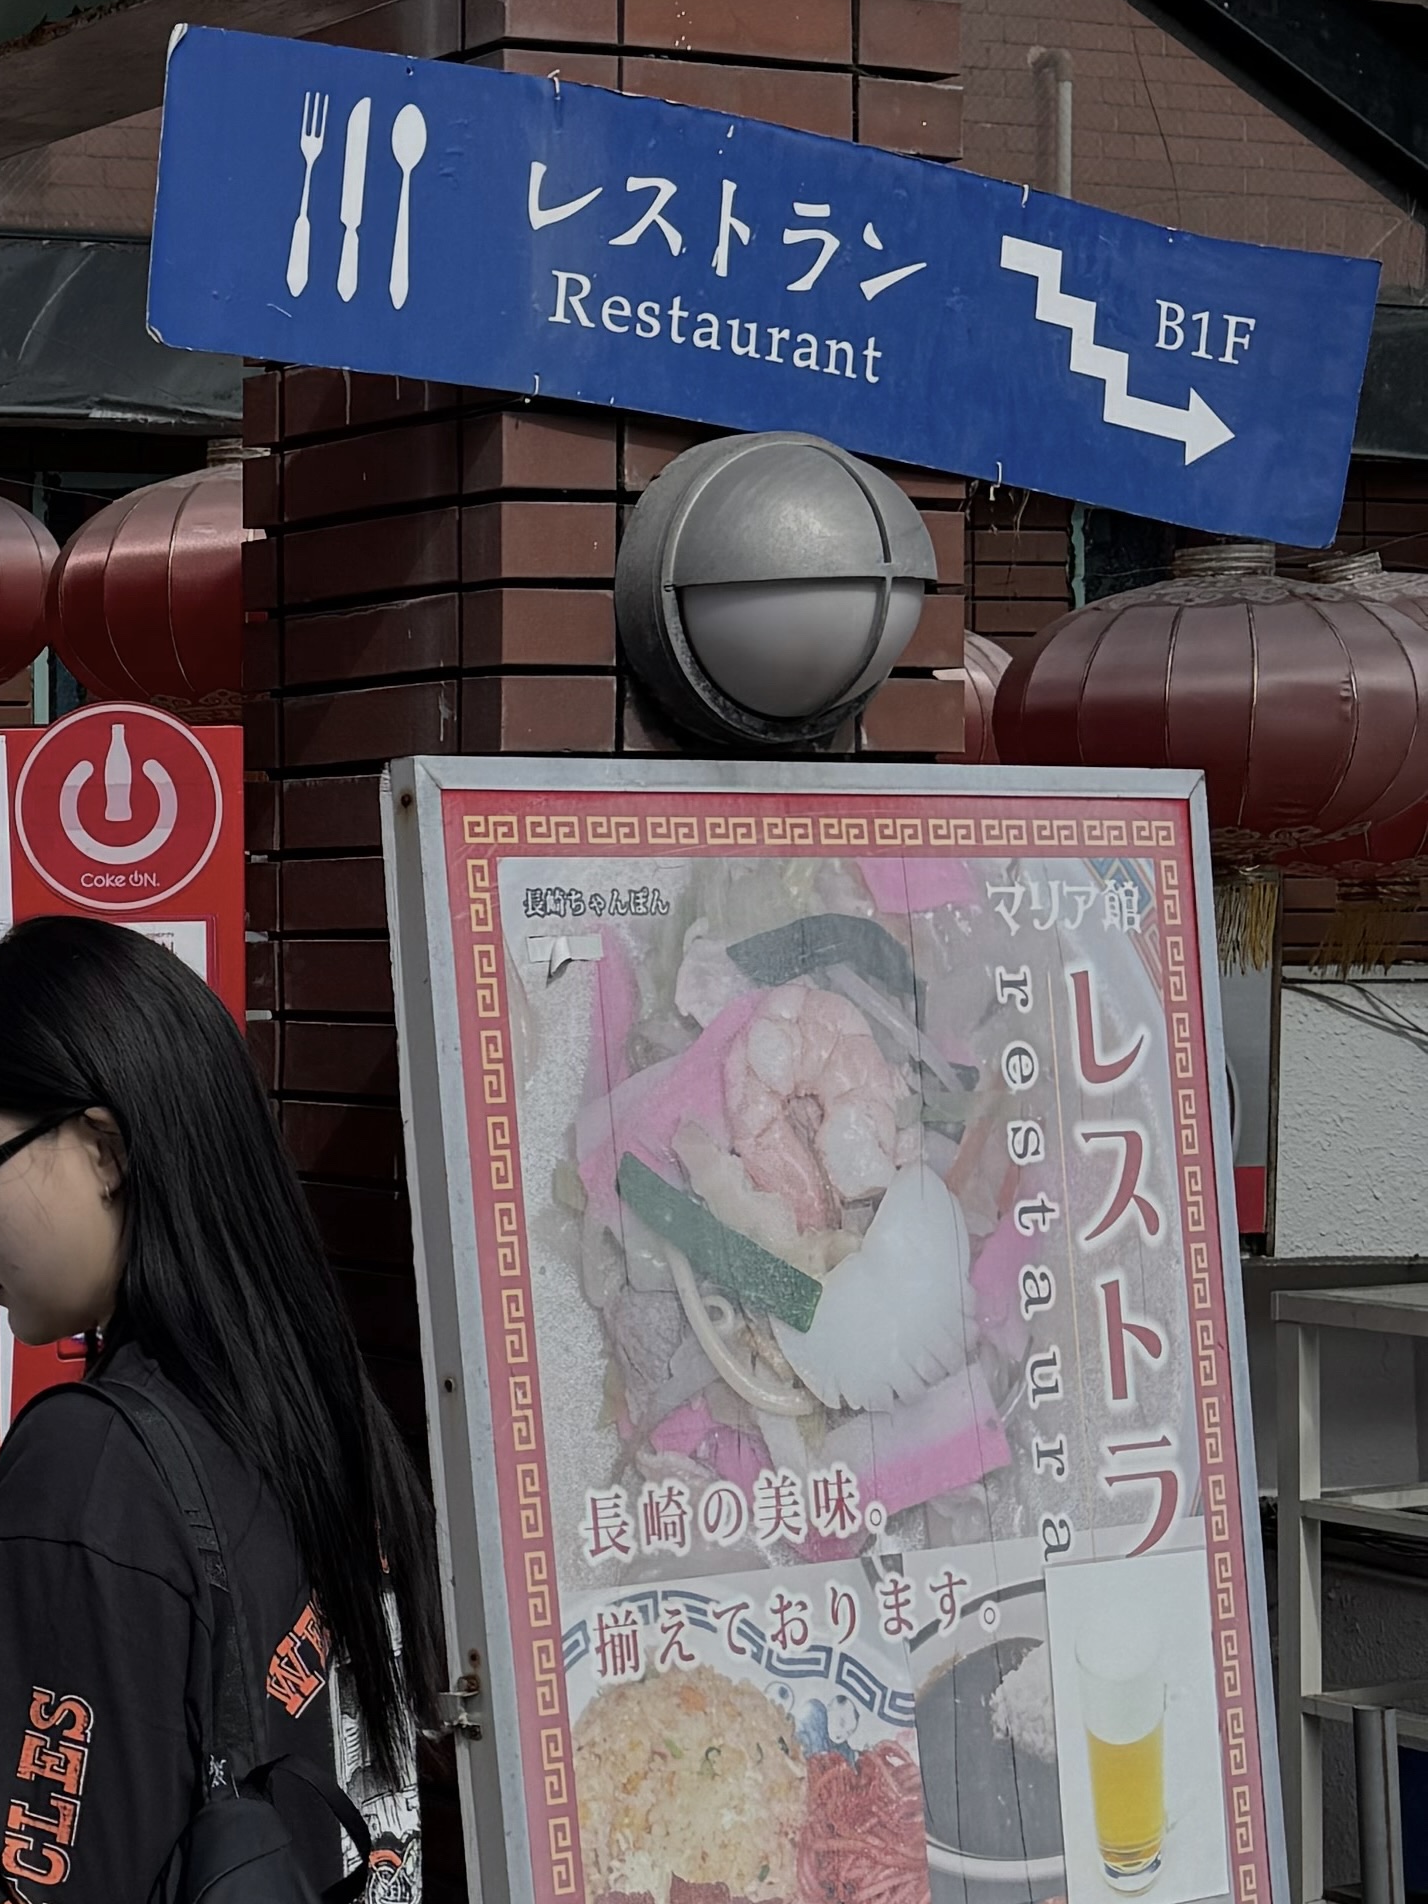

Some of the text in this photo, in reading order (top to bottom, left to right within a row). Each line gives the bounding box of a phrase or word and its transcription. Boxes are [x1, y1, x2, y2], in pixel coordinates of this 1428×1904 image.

[528, 160, 930, 302] レストラン
[546, 267, 885, 386] Restaurant
[1155, 298, 1257, 367] B1F
[80, 872, 127, 888] Coke
[522, 886, 670, 919] 長崎ちゃんぽん
[982, 874, 1145, 939] マリア館
[1067, 966, 1185, 1558] レストラ
[578, 1464, 888, 1564] 長崎の美味。
[591, 1566, 1000, 1678] 揃えております。
